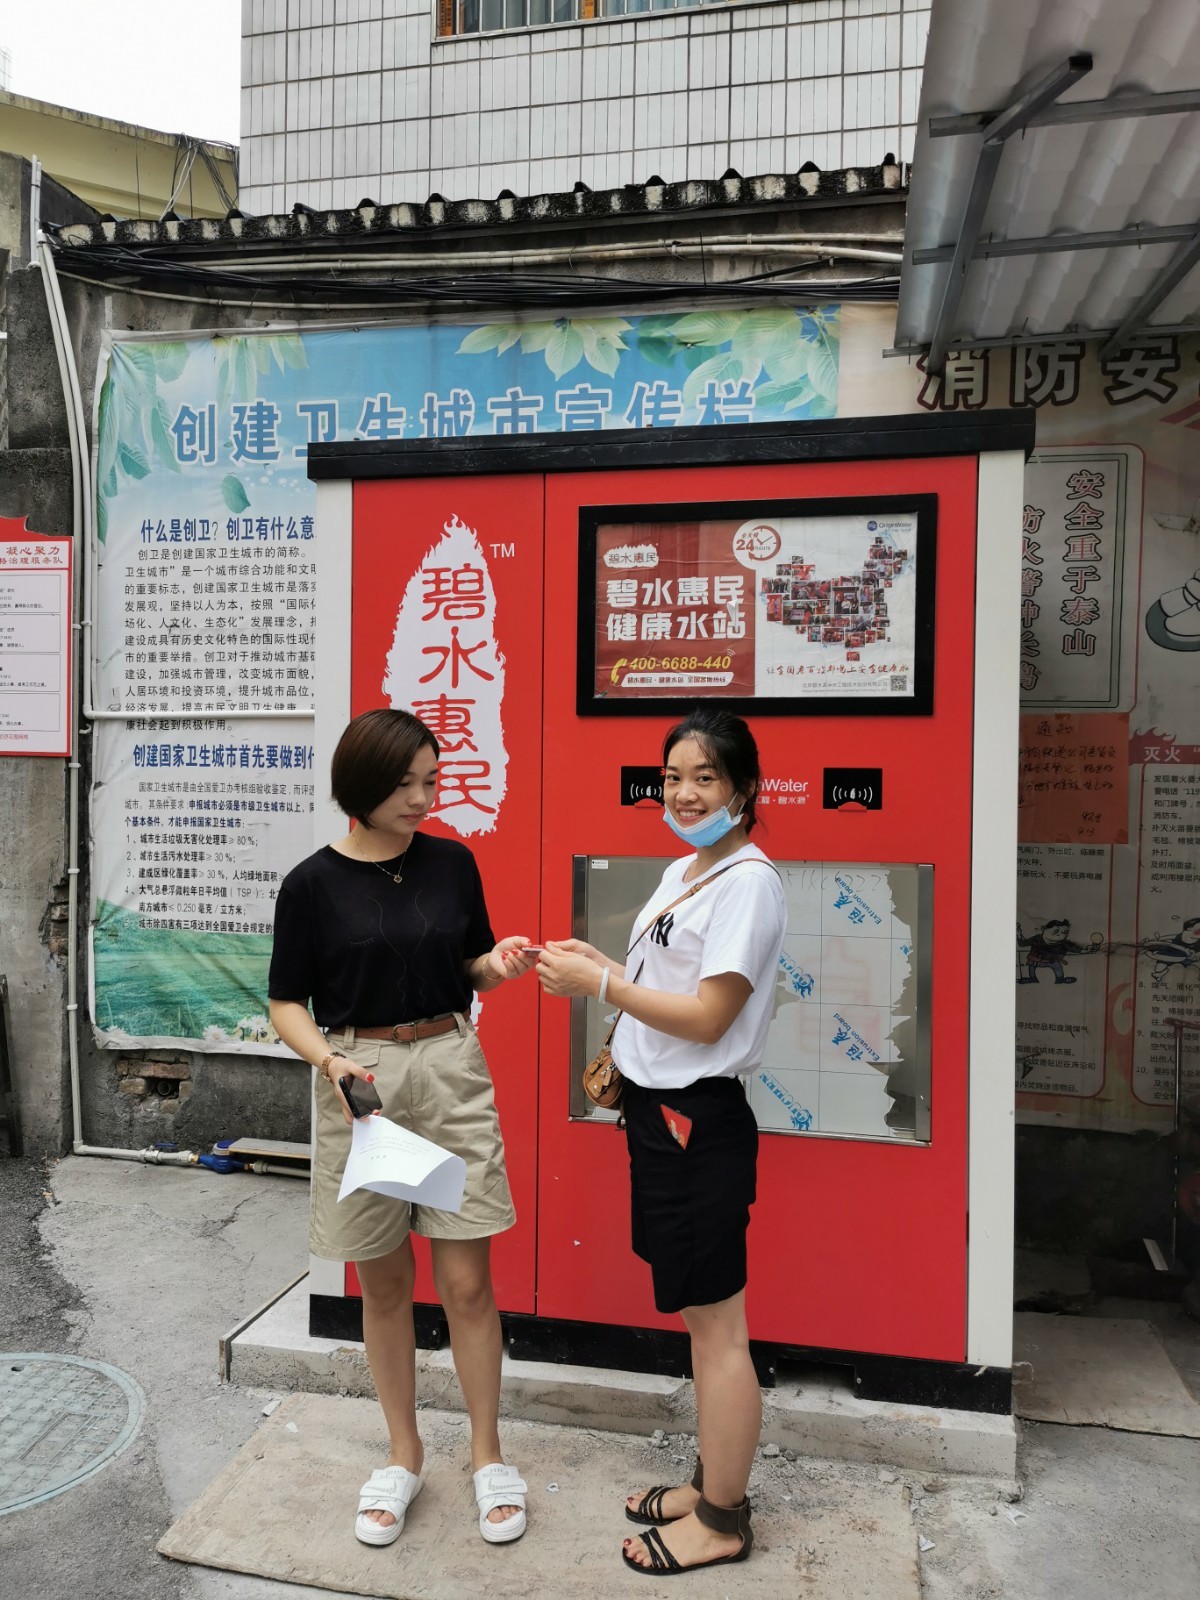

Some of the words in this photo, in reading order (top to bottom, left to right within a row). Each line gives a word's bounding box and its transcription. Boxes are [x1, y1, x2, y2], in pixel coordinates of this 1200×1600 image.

[6, 545, 61, 556] 凝心聚力
[490, 543, 515, 558] TM
[736, 539, 755, 551] 24
[138, 546, 306, 561] 创卫是创建国家卫生城市的简称。
[608, 551, 657, 564] 碧水惠民
[1060, 469, 1105, 656] 安全重于泰山
[606, 575, 745, 608] 碧水惠民
[606, 611, 746, 641] 健康水站
[629, 655, 732, 671] 400-6688-440
[411, 562, 497, 815] 碧水惠民
